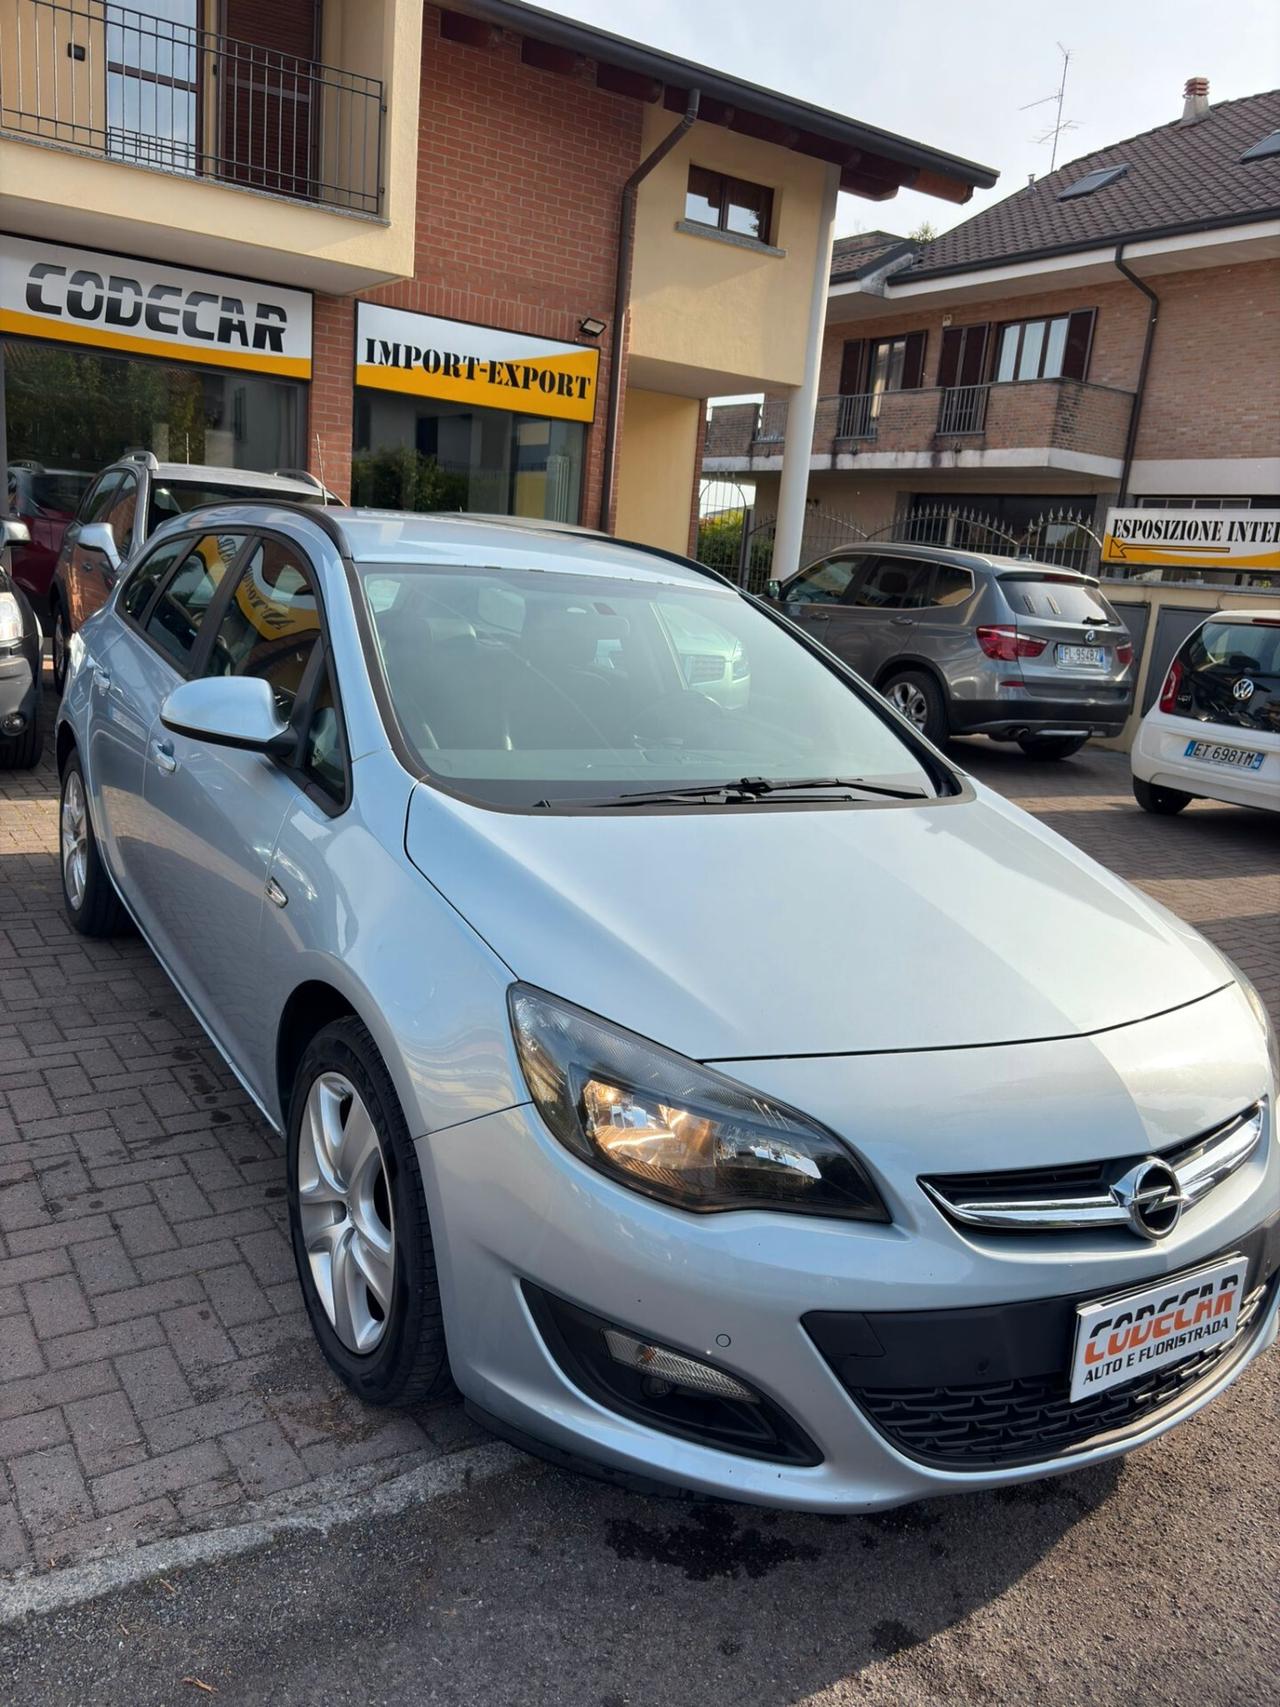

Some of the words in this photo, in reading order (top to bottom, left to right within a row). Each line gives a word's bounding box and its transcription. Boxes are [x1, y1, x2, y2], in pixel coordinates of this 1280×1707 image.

[25, 262, 288, 353] CODECAR
[366, 338, 591, 399] IMPORT-EXPORT
[1112, 518, 1223, 542] ESPOSIZIONE
[1193, 743, 1211, 757] ET
[1212, 746, 1255, 766] 698TM
[1083, 1356, 1122, 1385] AUTO
[1126, 1352, 1135, 1367] E
[1138, 1317, 1229, 1363] FUORISTRADA
[1084, 1274, 1239, 1366] CODECAR
